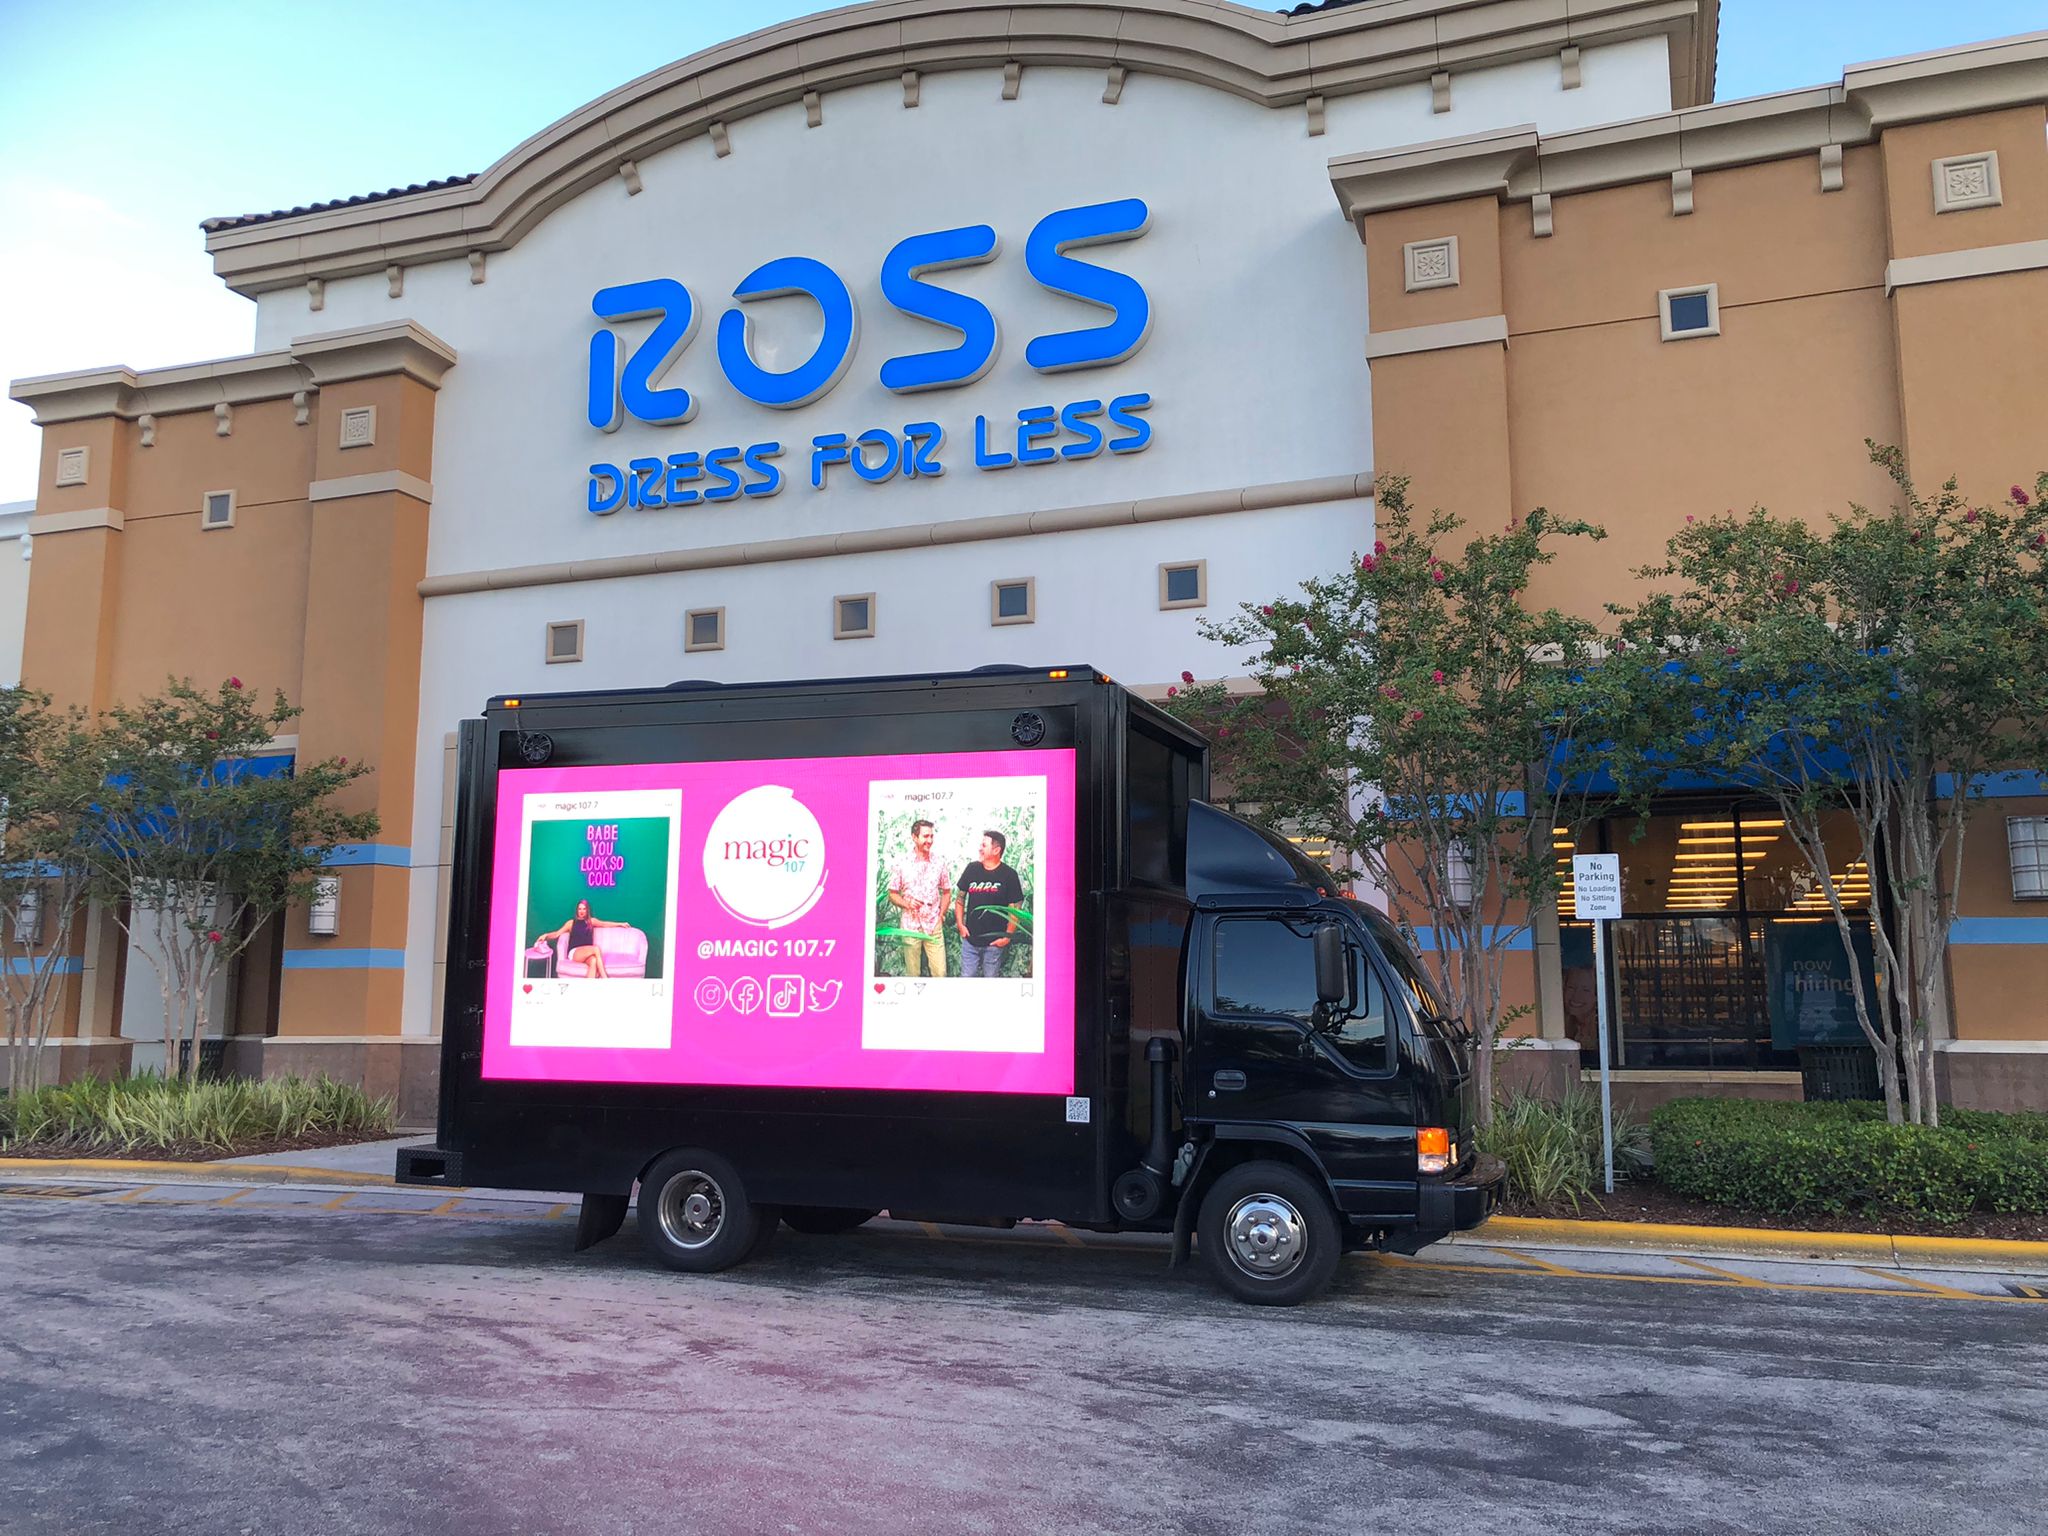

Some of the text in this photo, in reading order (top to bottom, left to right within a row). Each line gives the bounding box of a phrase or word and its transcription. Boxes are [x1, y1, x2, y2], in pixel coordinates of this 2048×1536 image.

[588, 198, 1151, 429] ROSS
[588, 393, 1152, 515] DRESS FOR LESS
[586, 824, 619, 841] BABE
[592, 841, 614, 856] YOU
[724, 833, 809, 867] magic
[580, 856, 624, 871] LOOK SO
[784, 860, 805, 873] 107
[1589, 862, 1603, 870] No
[588, 871, 616, 886] COOL
[1578, 872, 1615, 882] Parking
[1589, 885, 1617, 893] Loading
[697, 939, 836, 959] @MAGIC 107.7
[1793, 960, 1832, 971] now
[1794, 974, 1855, 996] hiring
